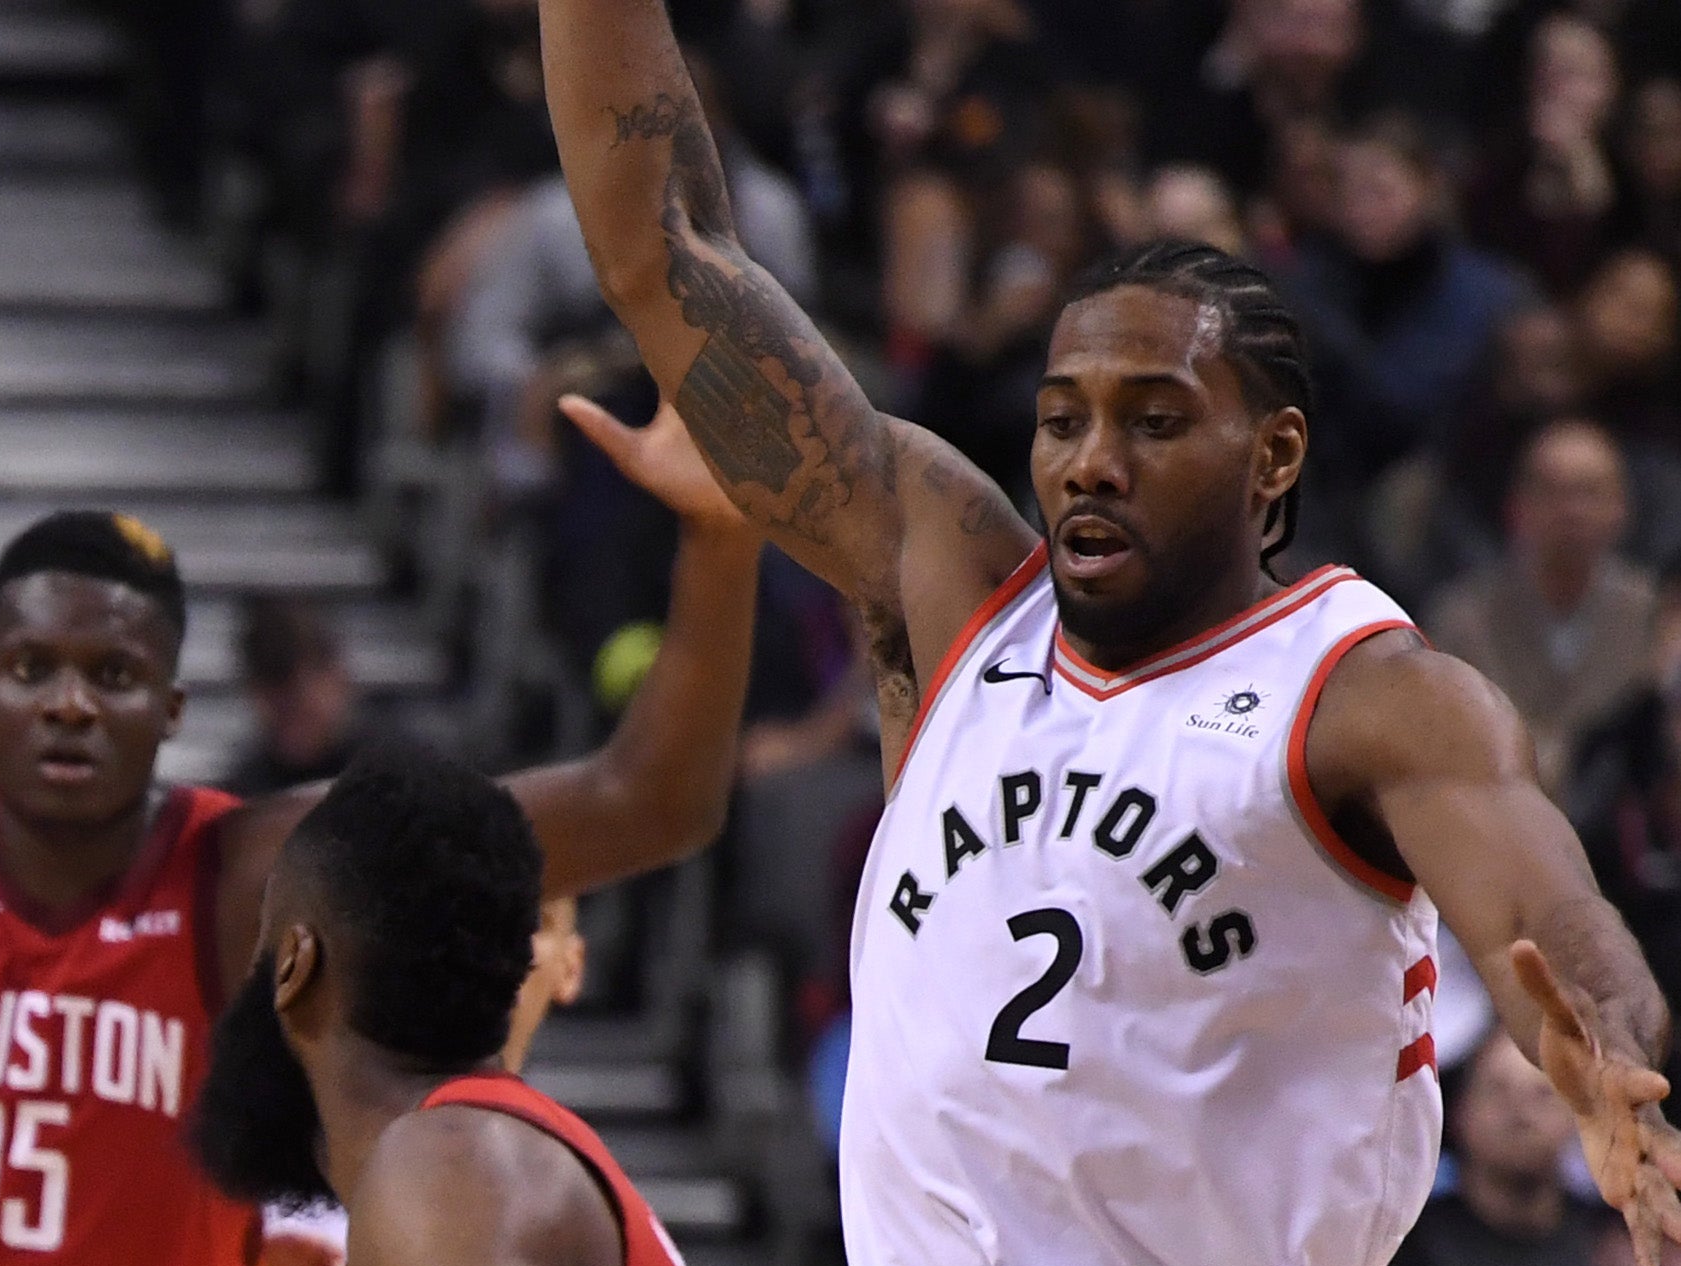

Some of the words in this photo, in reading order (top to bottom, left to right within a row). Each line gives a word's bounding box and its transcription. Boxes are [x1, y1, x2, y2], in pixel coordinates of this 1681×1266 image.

[1186, 714, 1221, 730] Sun
[1224, 721, 1260, 738] Life
[887, 766, 1259, 977] RAPTORS
[985, 907, 1084, 1070] 2
